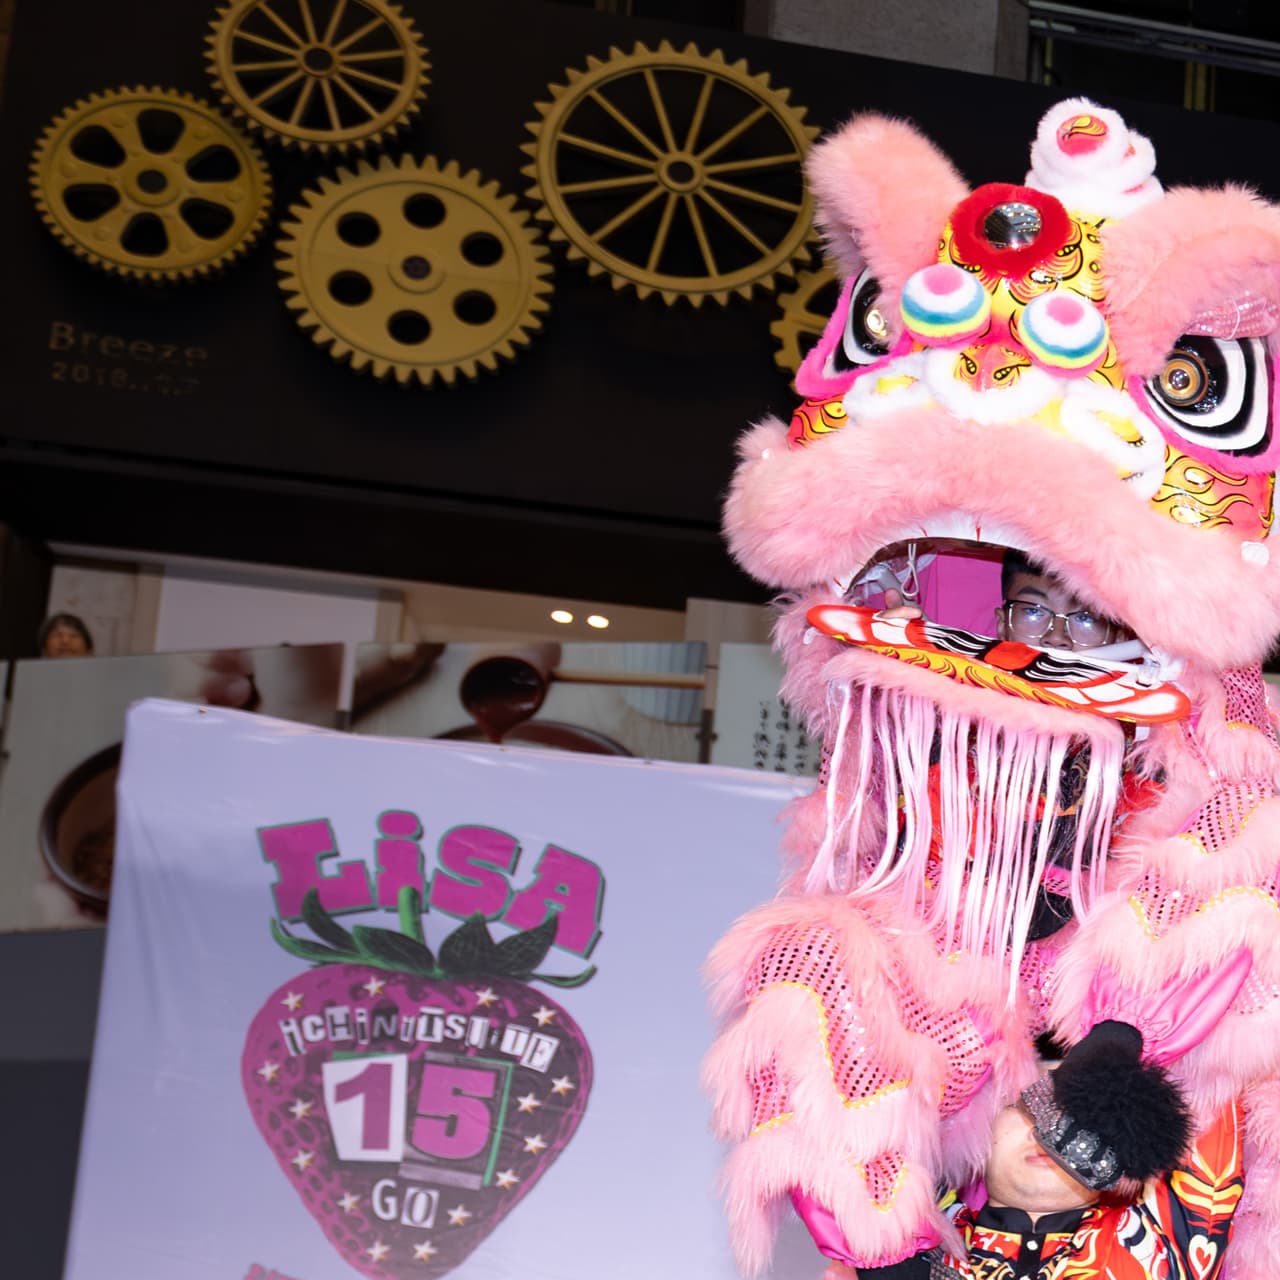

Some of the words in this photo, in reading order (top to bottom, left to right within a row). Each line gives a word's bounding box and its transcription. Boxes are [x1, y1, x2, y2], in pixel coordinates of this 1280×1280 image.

[47, 320, 210, 370] Breeze
[256, 810, 606, 959] LiSA
[326, 1060, 502, 1164] 15
[371, 1178, 440, 1229] GO
